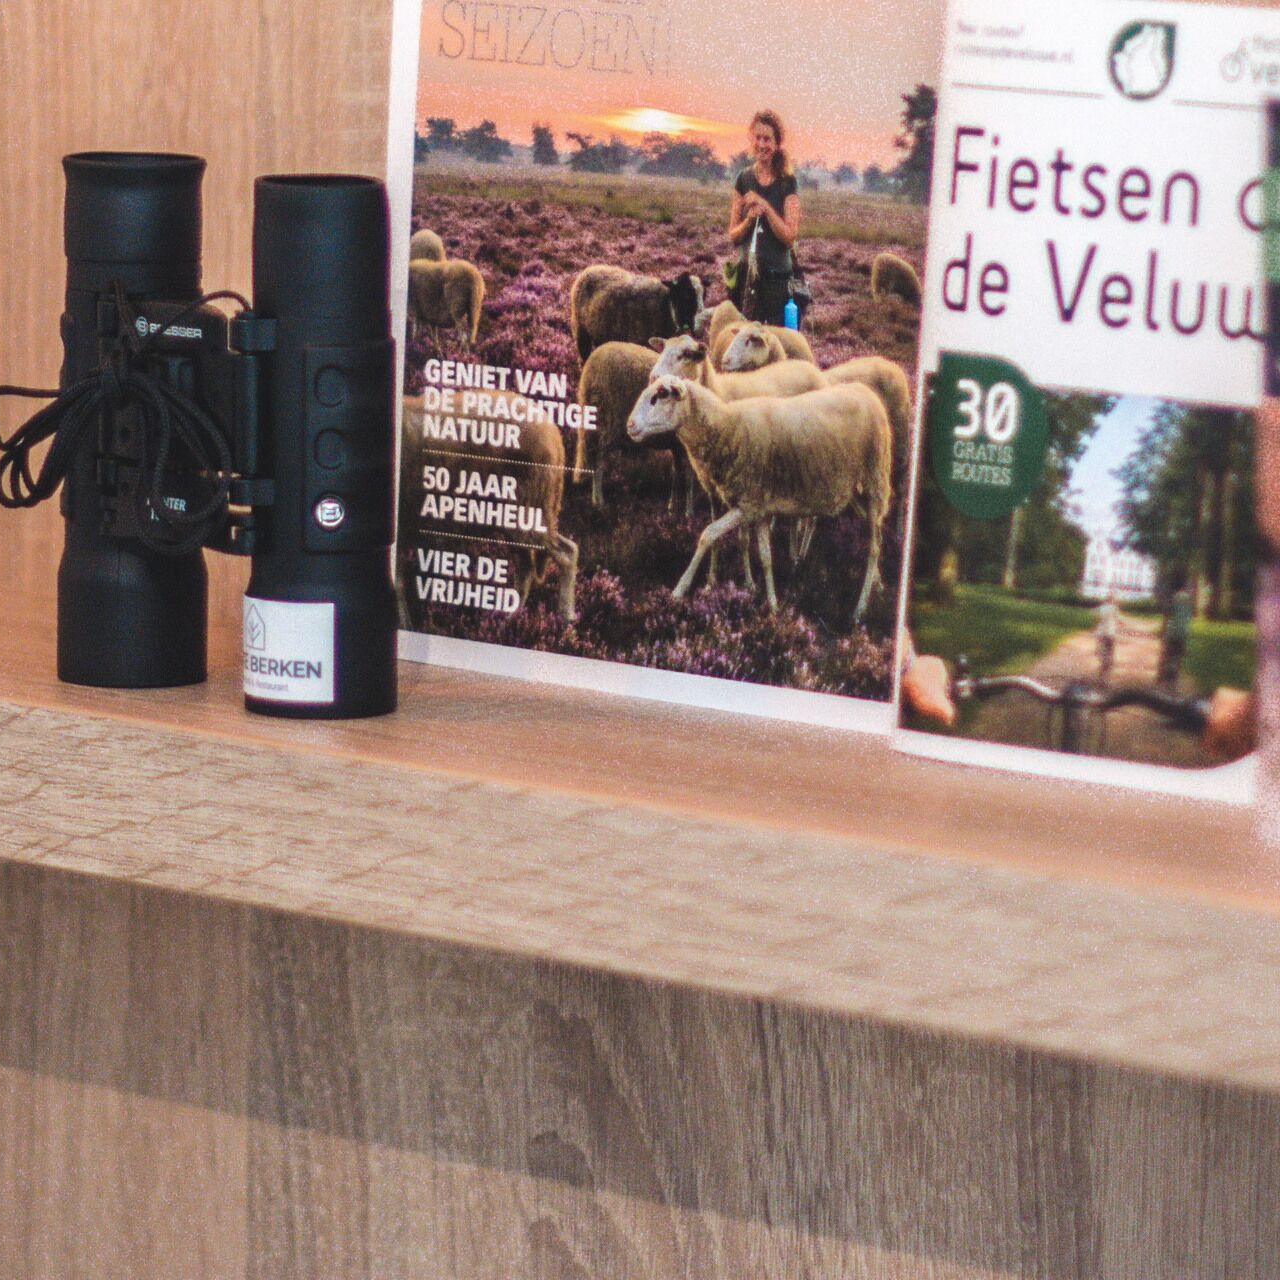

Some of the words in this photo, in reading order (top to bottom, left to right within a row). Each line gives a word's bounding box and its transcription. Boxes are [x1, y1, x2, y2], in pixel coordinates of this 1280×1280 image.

[949, 124, 1201, 227] Fietsen
[942, 232, 1009, 317] de
[1046, 238, 1266, 342] Veluw
[424, 358, 511, 391] GENIET
[514, 369, 567, 399] VAN
[423, 385, 456, 414] DE
[462, 389, 598, 431] PRACHTIGE
[953, 378, 1019, 443] 30
[422, 413, 521, 450] NATUUR
[422, 464, 451, 492] 50
[455, 469, 518, 501] JAAR
[420, 493, 548, 533] APENHEUL
[417, 547, 471, 579] VIER
[477, 555, 509, 584] DE
[415, 575, 521, 614] VRIJHEID
[250, 655, 323, 679] BERKEN
